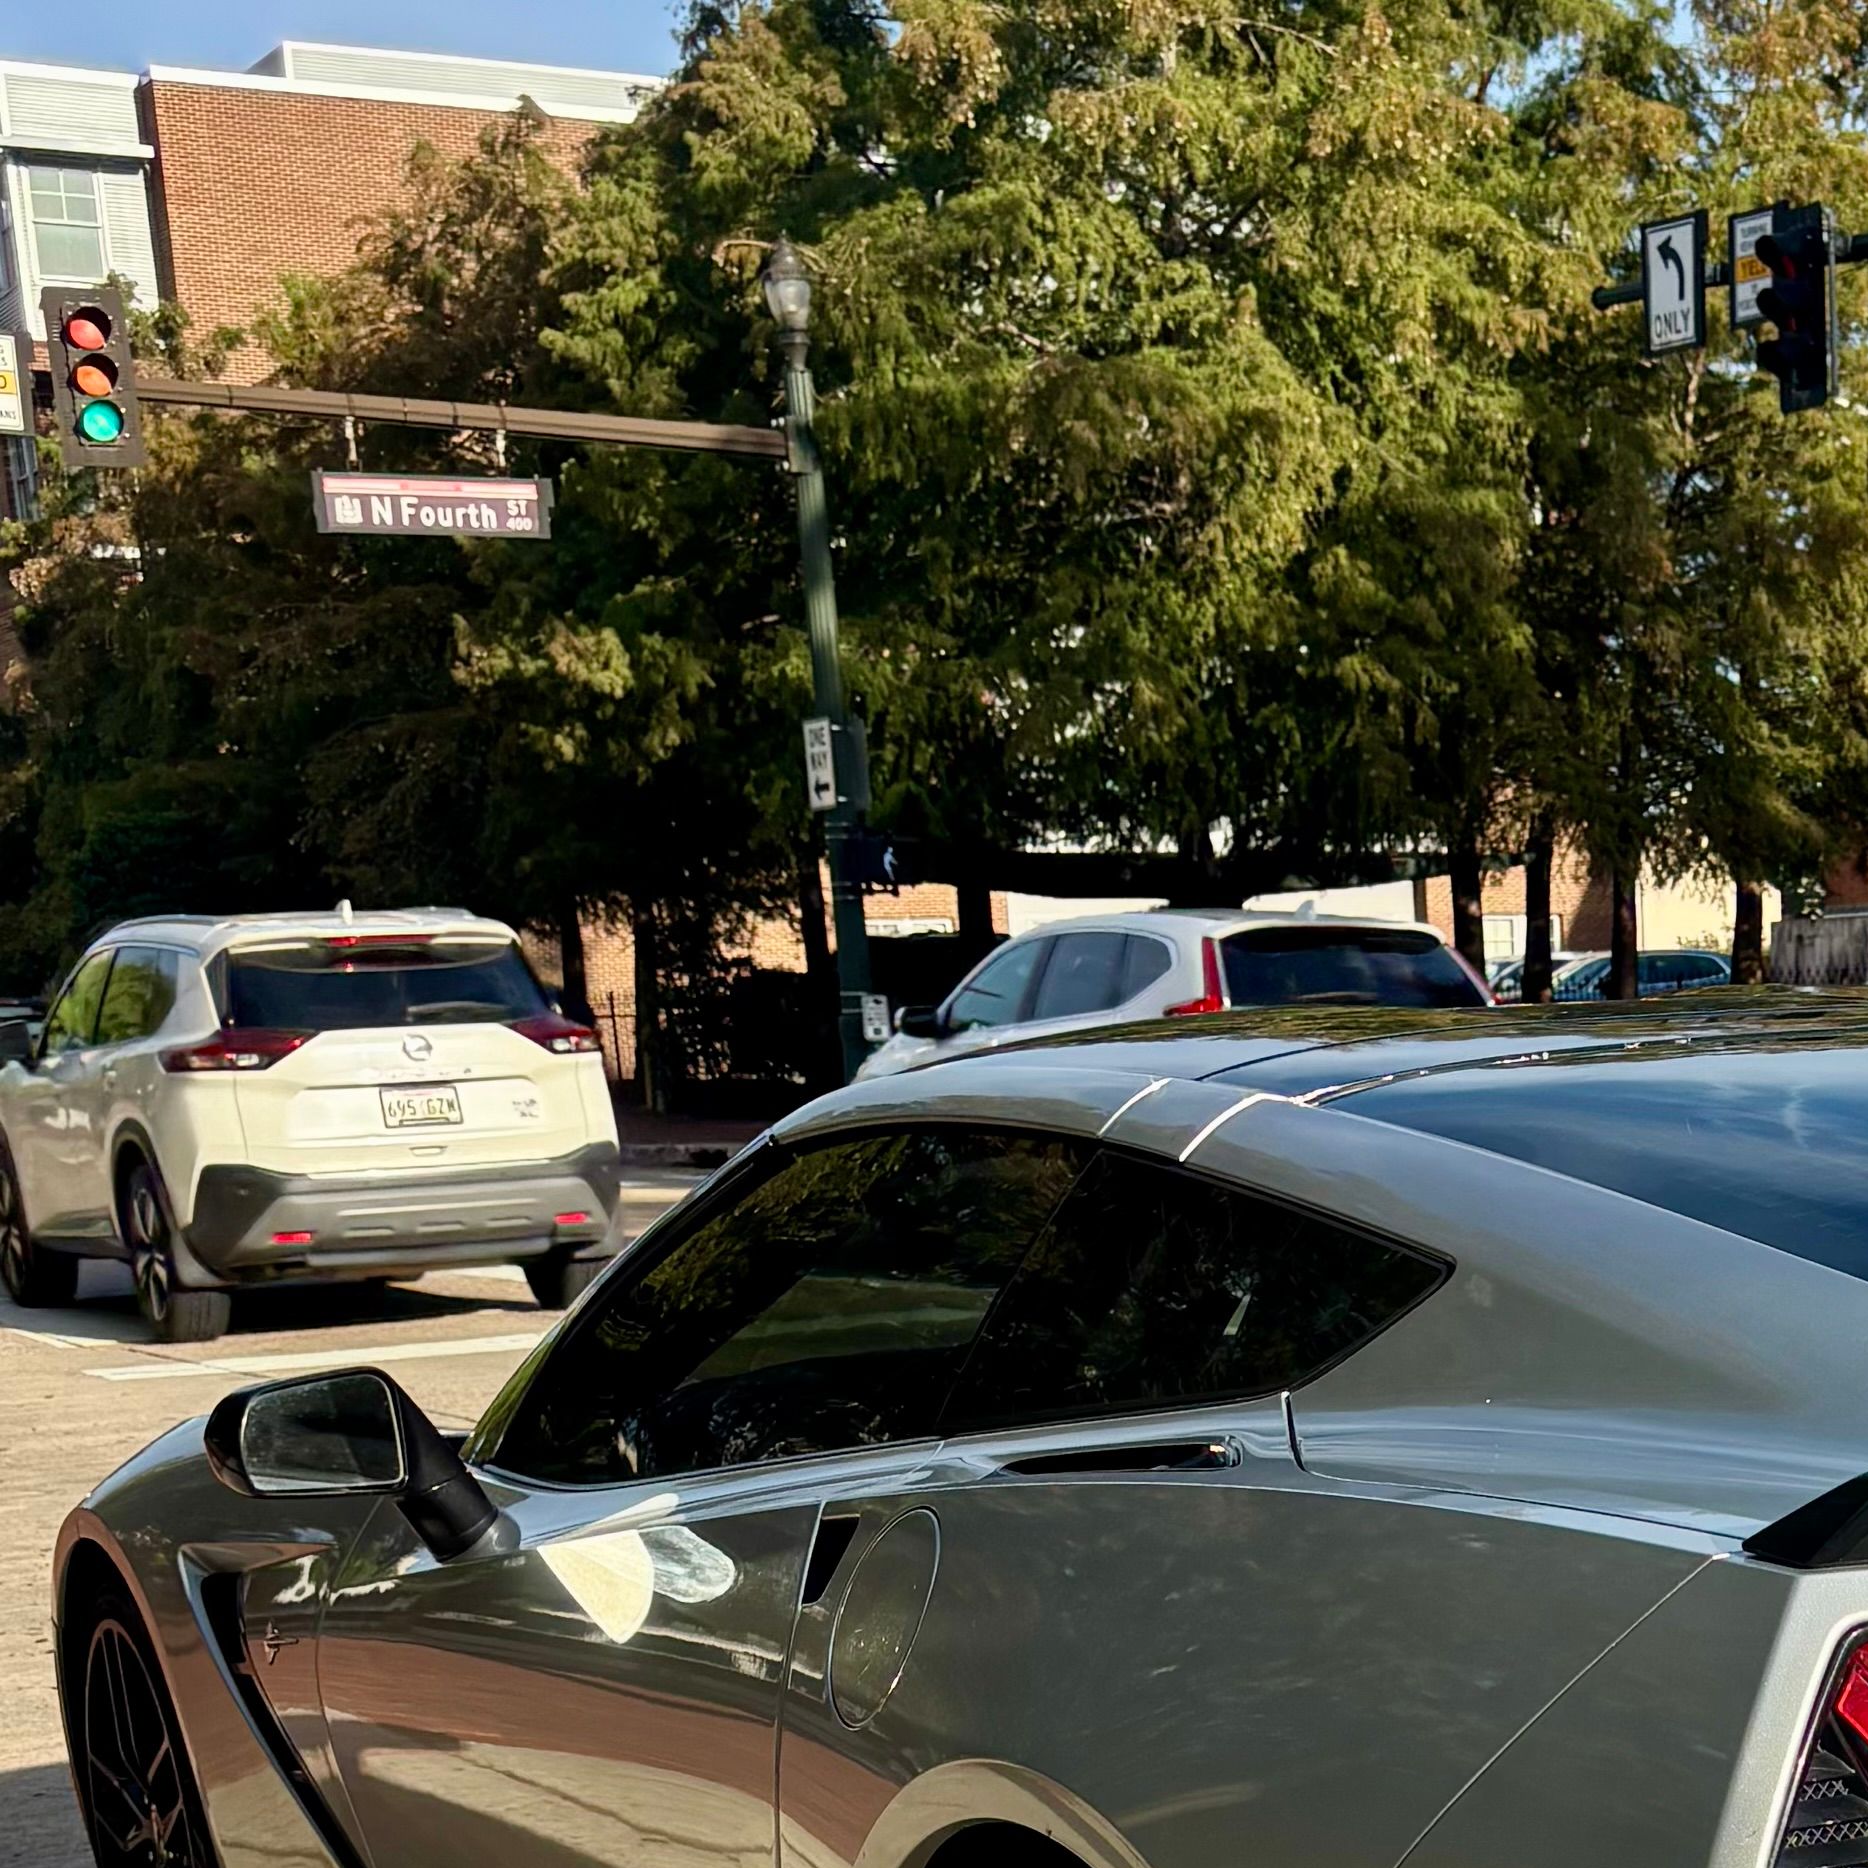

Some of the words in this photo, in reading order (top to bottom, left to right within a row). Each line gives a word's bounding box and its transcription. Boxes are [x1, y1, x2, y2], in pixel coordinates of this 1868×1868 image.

[1654, 307, 1690, 338] ONLY
[370, 496, 394, 526] N
[400, 496, 498, 529] Fourth
[507, 499, 527, 517] ST
[506, 517, 533, 532] 400
